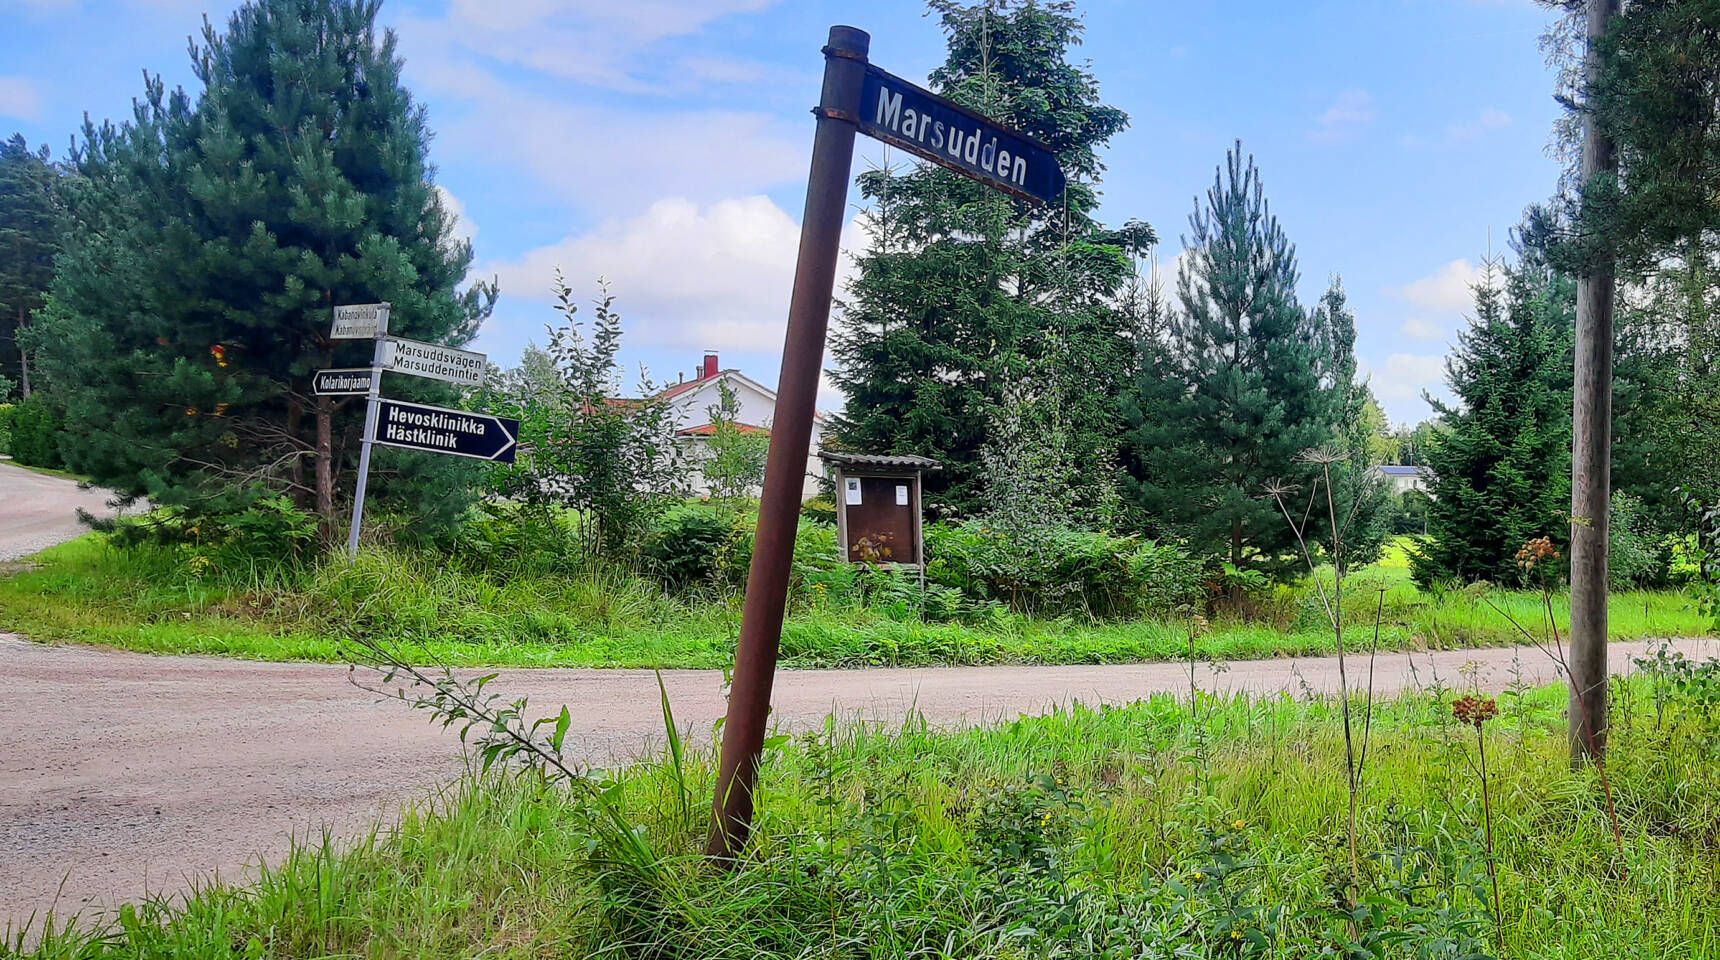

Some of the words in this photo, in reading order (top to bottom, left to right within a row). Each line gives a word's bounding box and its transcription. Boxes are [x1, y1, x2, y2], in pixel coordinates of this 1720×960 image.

[876, 86, 1027, 185] Marsudden
[394, 356, 478, 380] Marsuddenintie
[396, 342, 481, 369] Marsuddsvägen
[320, 375, 370, 391] Kolarikorjaamo
[389, 406, 485, 435] Hevosklinikka
[387, 424, 457, 448] Hästklinik
